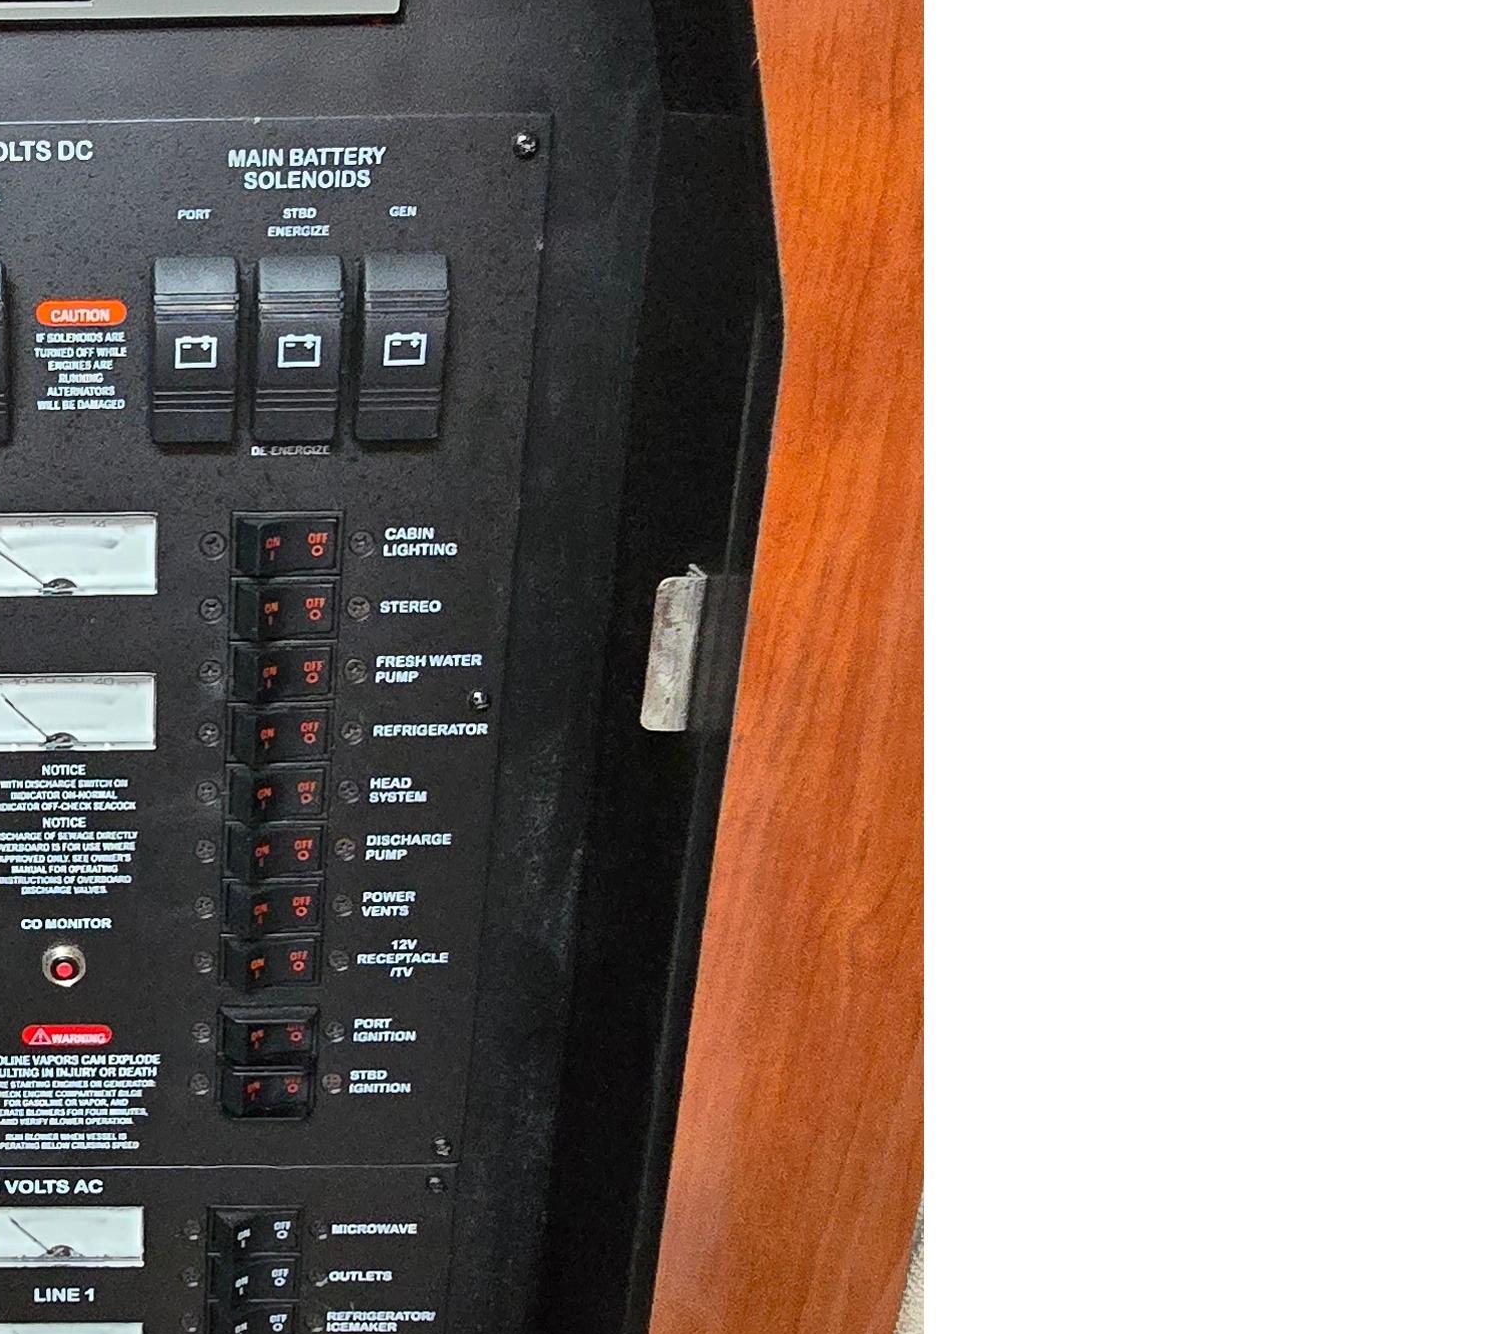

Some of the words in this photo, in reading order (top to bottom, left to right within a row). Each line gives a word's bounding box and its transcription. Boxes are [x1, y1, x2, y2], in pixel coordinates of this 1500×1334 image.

[58, 139, 93, 161] DC
[228, 149, 283, 168] MAIN
[289, 147, 387, 166] BATTERY
[244, 170, 371, 189] SOLENOIDS
[178, 209, 212, 219] PORT
[283, 208, 317, 219] STBD
[389, 206, 417, 217] GEN
[268, 225, 330, 237] ENERGIZE
[51, 309, 110, 323] CAUTION
[36, 333, 44, 343] IF
[47, 332, 102, 343] SOLENOIDS
[105, 332, 125, 342] ARE
[34, 348, 74, 358] TURNED
[76, 347, 94, 358] OFF
[96, 347, 127, 357] WHILE
[93, 360, 113, 370] ARE
[47, 386, 115, 396] ALTERNATORS
[37, 400, 60, 410] WILL
[62, 400, 75, 410] BE
[77, 399, 125, 410] DAMAGED
[307, 532, 328, 545] OFF
[385, 527, 435, 541] CABIN
[383, 543, 458, 557] LIGHTING
[305, 597, 326, 610] OFF
[380, 600, 442, 614] STEREO
[304, 661, 324, 672] OFF
[376, 655, 427, 669] FRESH
[429, 654, 483, 667] WATER
[375, 670, 419, 684] PUMP
[300, 721, 320, 733] OFF
[373, 722, 488, 737] REFRIGERATOR
[42, 764, 86, 776] NOTICE
[297, 781, 318, 793] OFF
[370, 777, 412, 790] HEAD
[369, 791, 427, 803] SYSTEM
[43, 817, 87, 828] NOTICE
[294, 839, 313, 851] OFF
[366, 833, 451, 847] DISCHARGE
[365, 849, 408, 861] PUMP
[292, 896, 312, 908] OFF
[362, 891, 416, 903] POWER
[362, 905, 409, 917] VENTS
[21, 919, 42, 930] CO
[45, 918, 112, 929] MONITOR
[391, 939, 418, 950] 12V
[289, 951, 308, 962] OFF
[357, 952, 449, 965] RECEPTACLE
[390, 967, 413, 978] /TV
[354, 1018, 392, 1030] PORT
[51, 1034, 105, 1044] WARNING
[353, 1030, 416, 1043] IGNITION
[32, 1055, 79, 1066] VAPORS
[81, 1055, 106, 1065] CAN
[108, 1054, 161, 1065] EXPLODE
[41, 1068, 53, 1078] IN
[56, 1068, 98, 1078] INJURY
[99, 1067, 117, 1077] OR
[119, 1067, 157, 1077] DEATH
[350, 1070, 387, 1081] STBD
[349, 1082, 411, 1094] IGNITION
[5, 1179, 69, 1194] VOLTS
[74, 1179, 103, 1194] AC
[332, 1223, 418, 1235] MICROWAVE
[329, 1271, 393, 1282] OUTLETS
[34, 1288, 80, 1302] LINE
[85, 1288, 95, 1301] 1
[326, 1311, 436, 1322] REFRIGERATOR/
[326, 1321, 397, 1333] ICEMAKER
